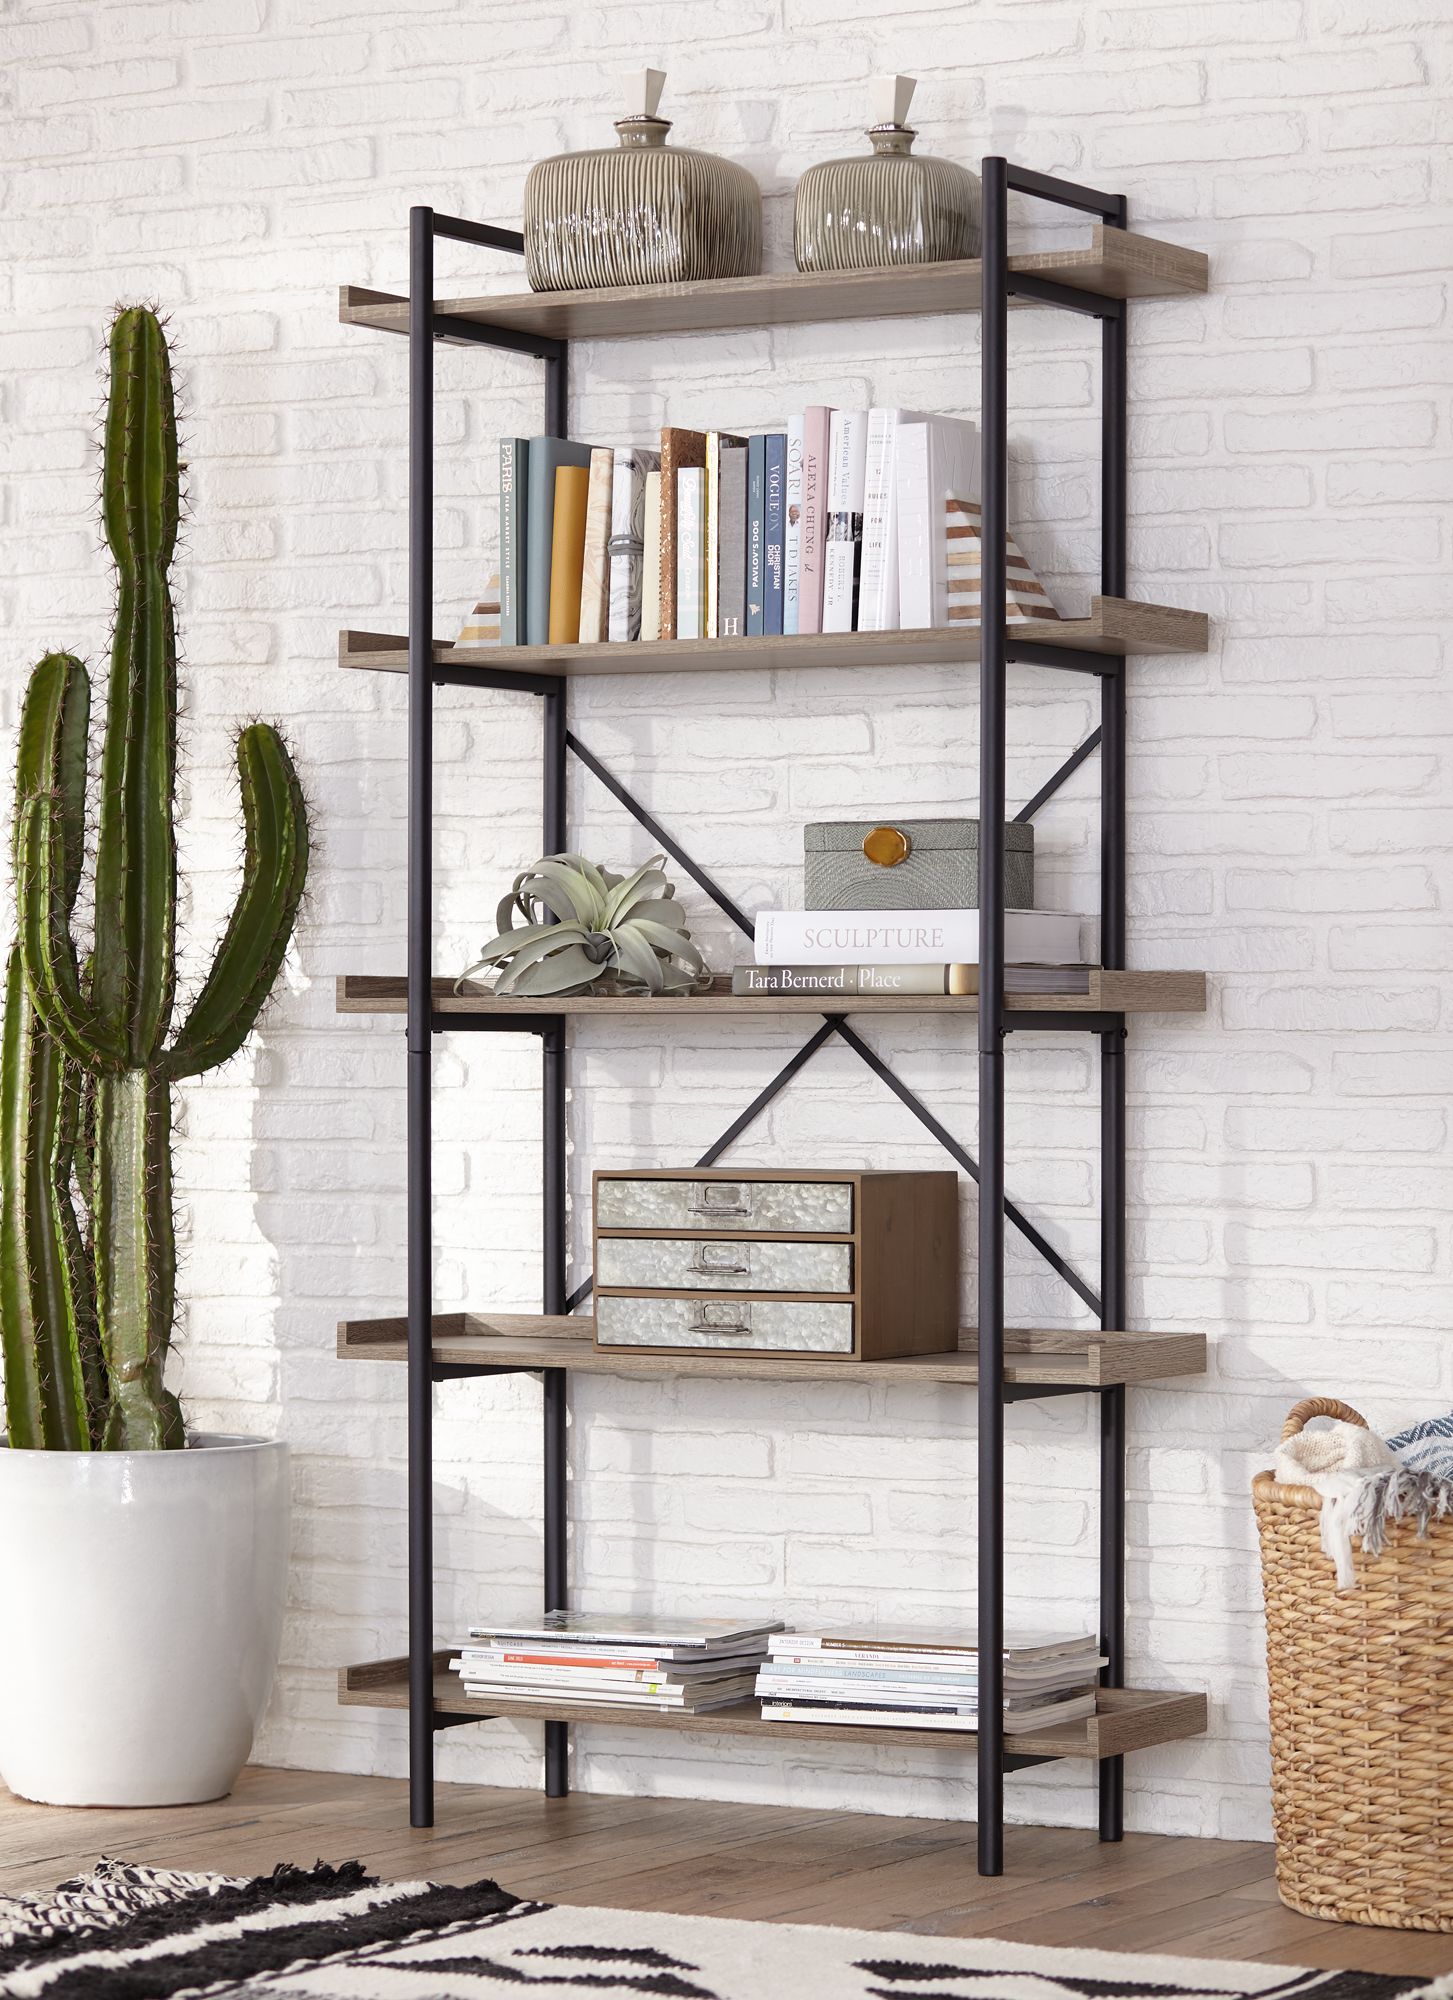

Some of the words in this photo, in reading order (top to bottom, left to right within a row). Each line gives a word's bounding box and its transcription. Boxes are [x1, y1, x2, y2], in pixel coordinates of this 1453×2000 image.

[842, 418, 852, 468] American
[501, 443, 512, 493] PARIS
[769, 465, 780, 512] VOGUE
[788, 438, 802, 495] SOAR!
[807, 454, 816, 501] ALEXA
[840, 472, 850, 506] Values
[768, 512, 779, 532] ON
[804, 506, 814, 554] CHUNG
[773, 544, 781, 590] CHRISTIAN
[723, 617, 738, 636] H
[803, 927, 945, 949] SCULPTURE
[745, 969, 778, 989] Tara
[781, 968, 845, 989] Bernerd
[859, 968, 901, 988] Place
[843, 1670, 887, 1679] LANDSCAPES
